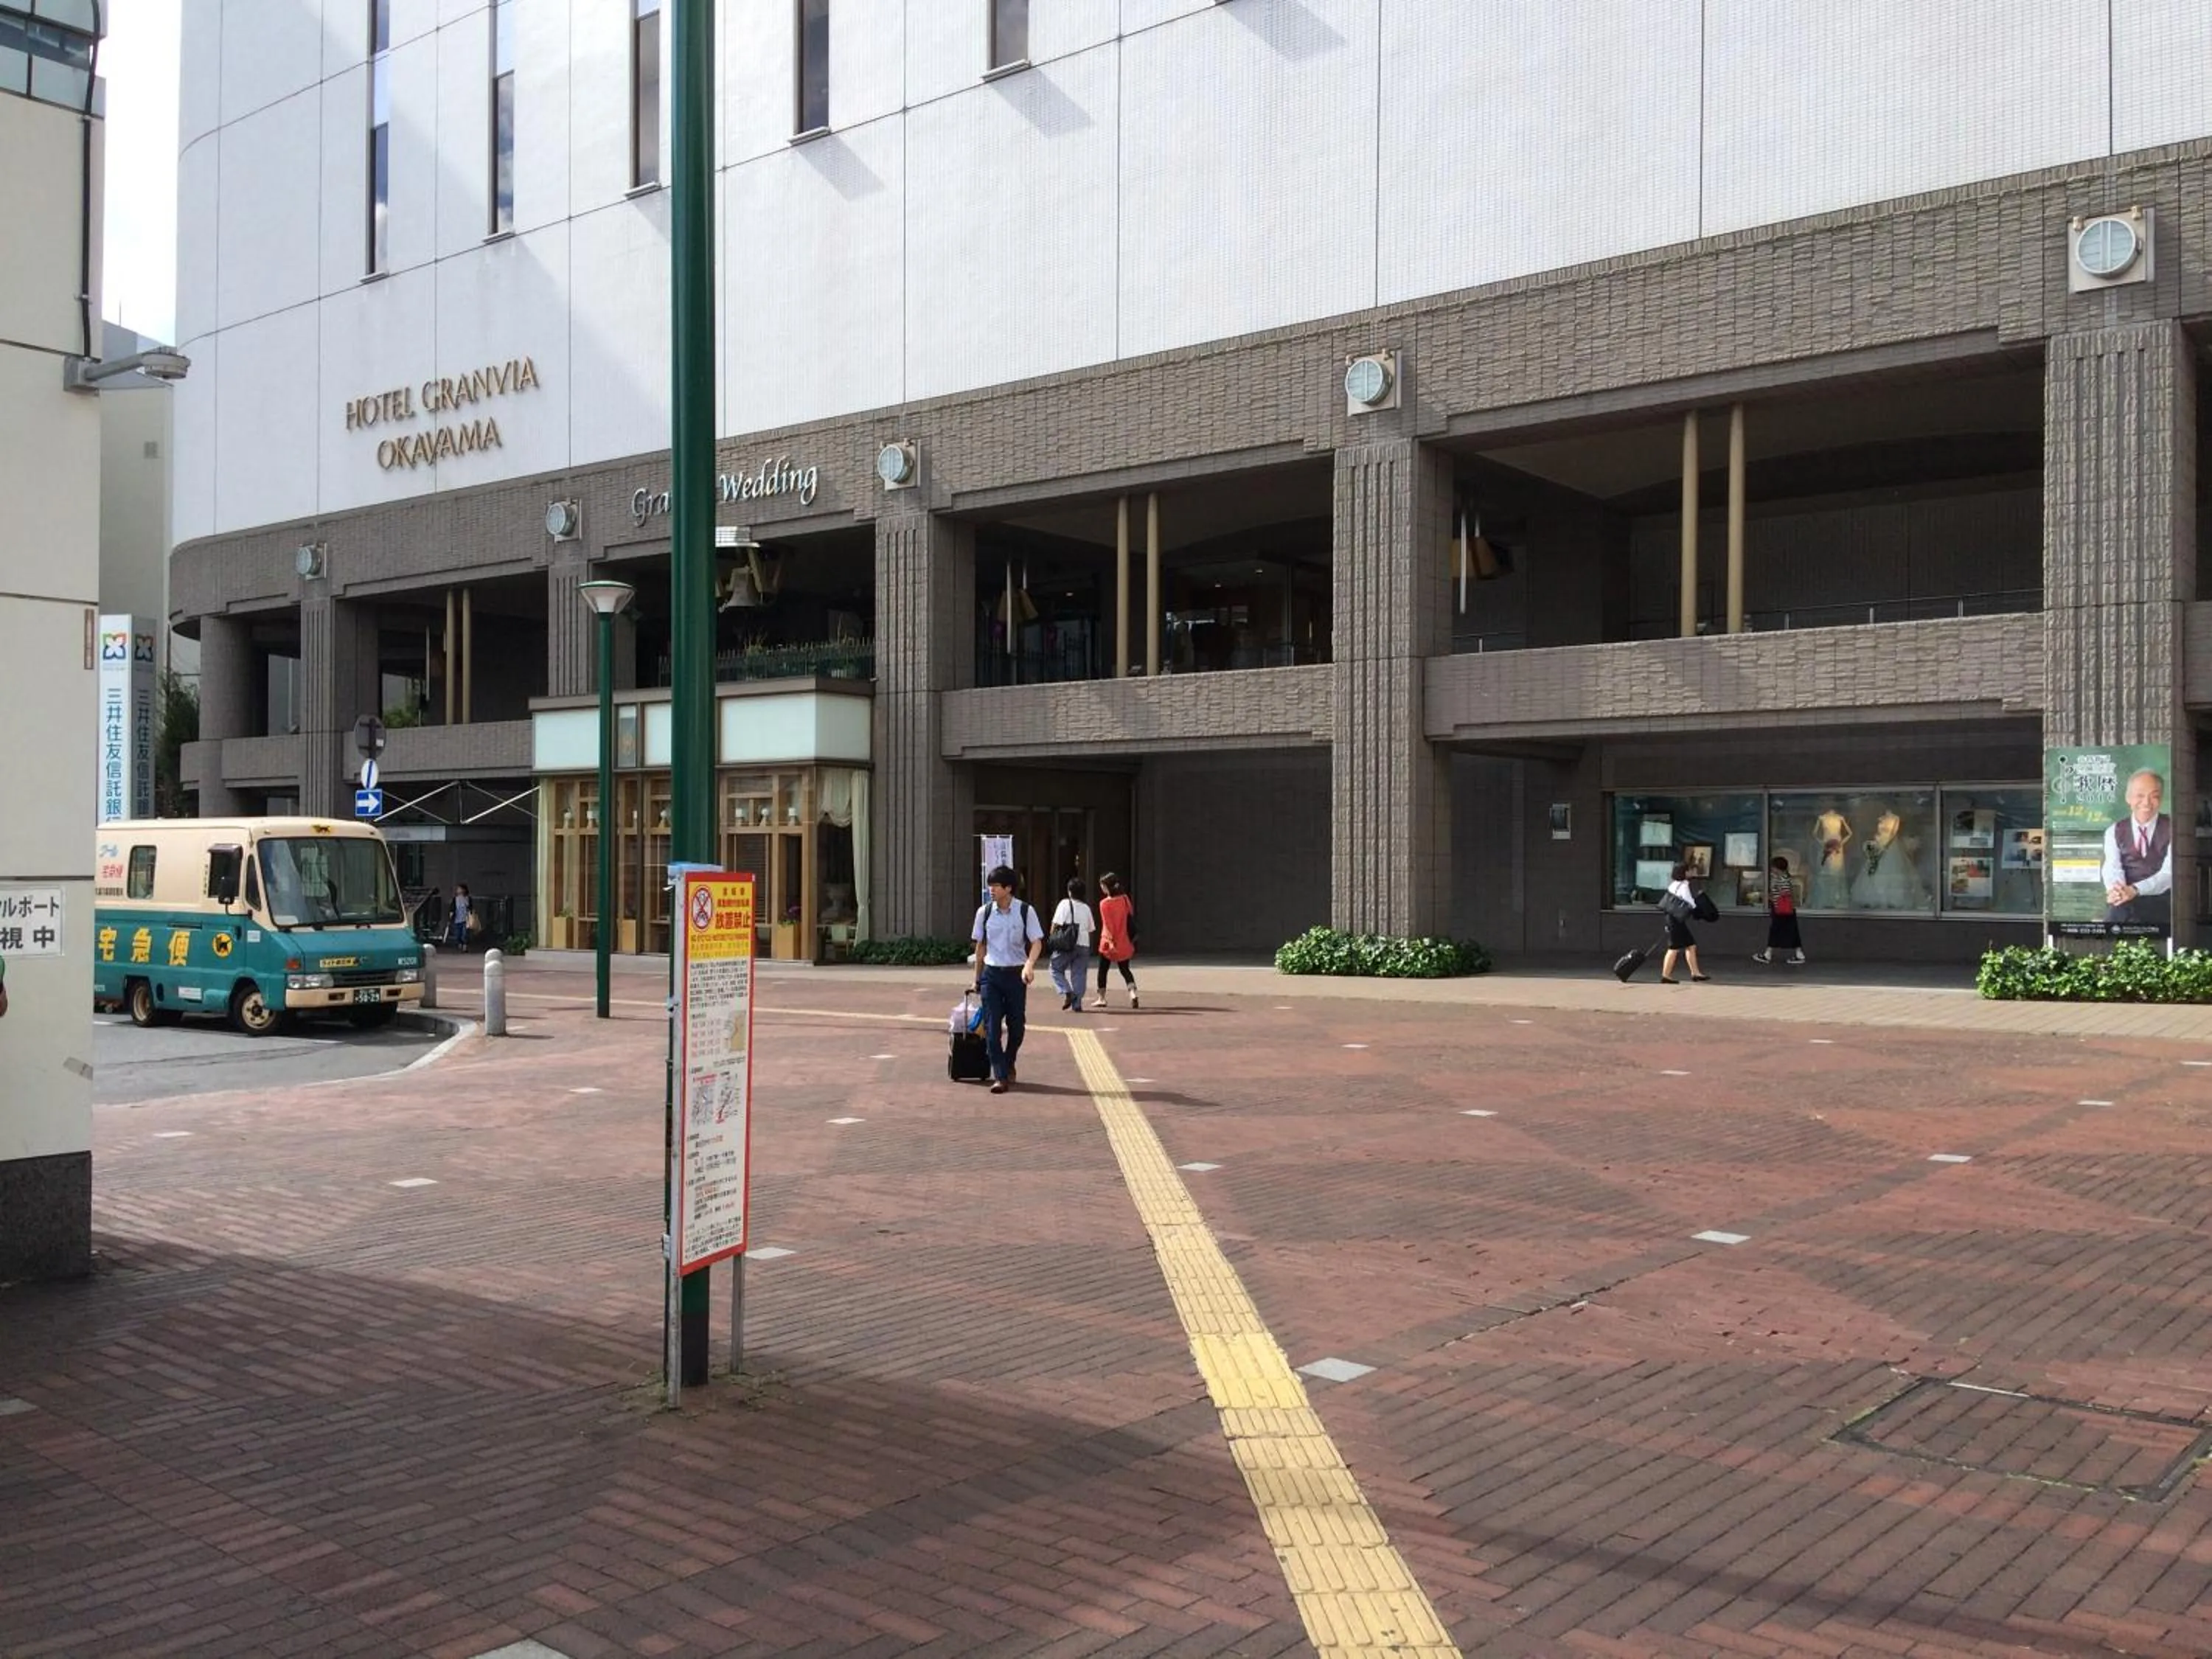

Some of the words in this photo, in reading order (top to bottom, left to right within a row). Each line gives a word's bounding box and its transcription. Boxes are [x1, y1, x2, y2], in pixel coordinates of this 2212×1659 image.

[346, 386, 416, 431] HOTEL
[422, 356, 540, 412] GRANVIA
[377, 417, 503, 470] OKAYAMA
[719, 454, 818, 506] Wedding
[0, 895, 59, 918] ルポート
[99, 926, 190, 966] 宅急便
